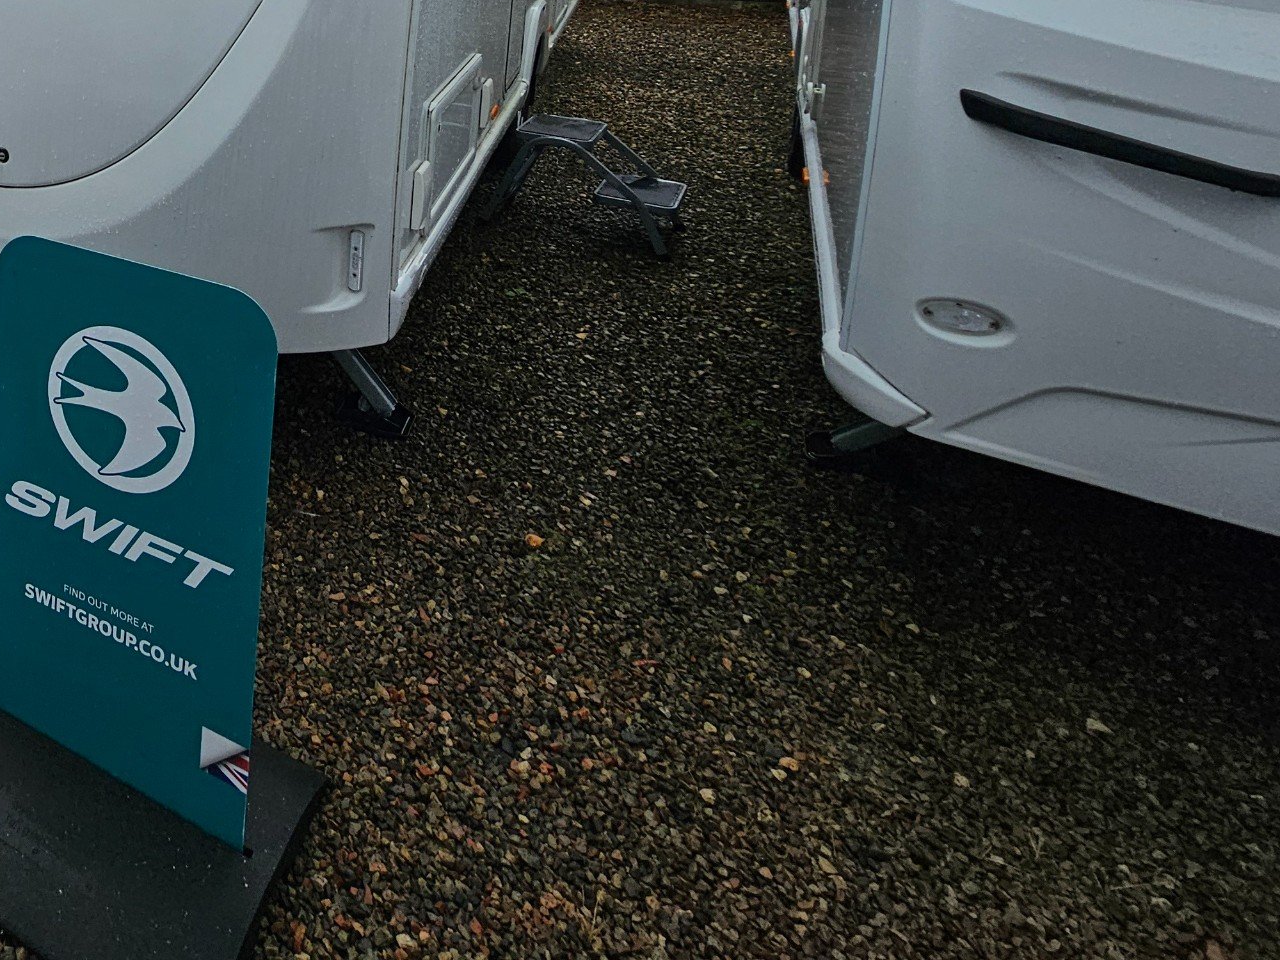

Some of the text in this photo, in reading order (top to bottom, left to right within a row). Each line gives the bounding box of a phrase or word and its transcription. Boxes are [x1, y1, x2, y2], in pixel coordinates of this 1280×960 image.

[4, 480, 235, 589] SWIFT
[24, 583, 198, 681] SWIFTGROUP.CO.UK
[63, 583, 155, 634] FIND OUT MORE AT
